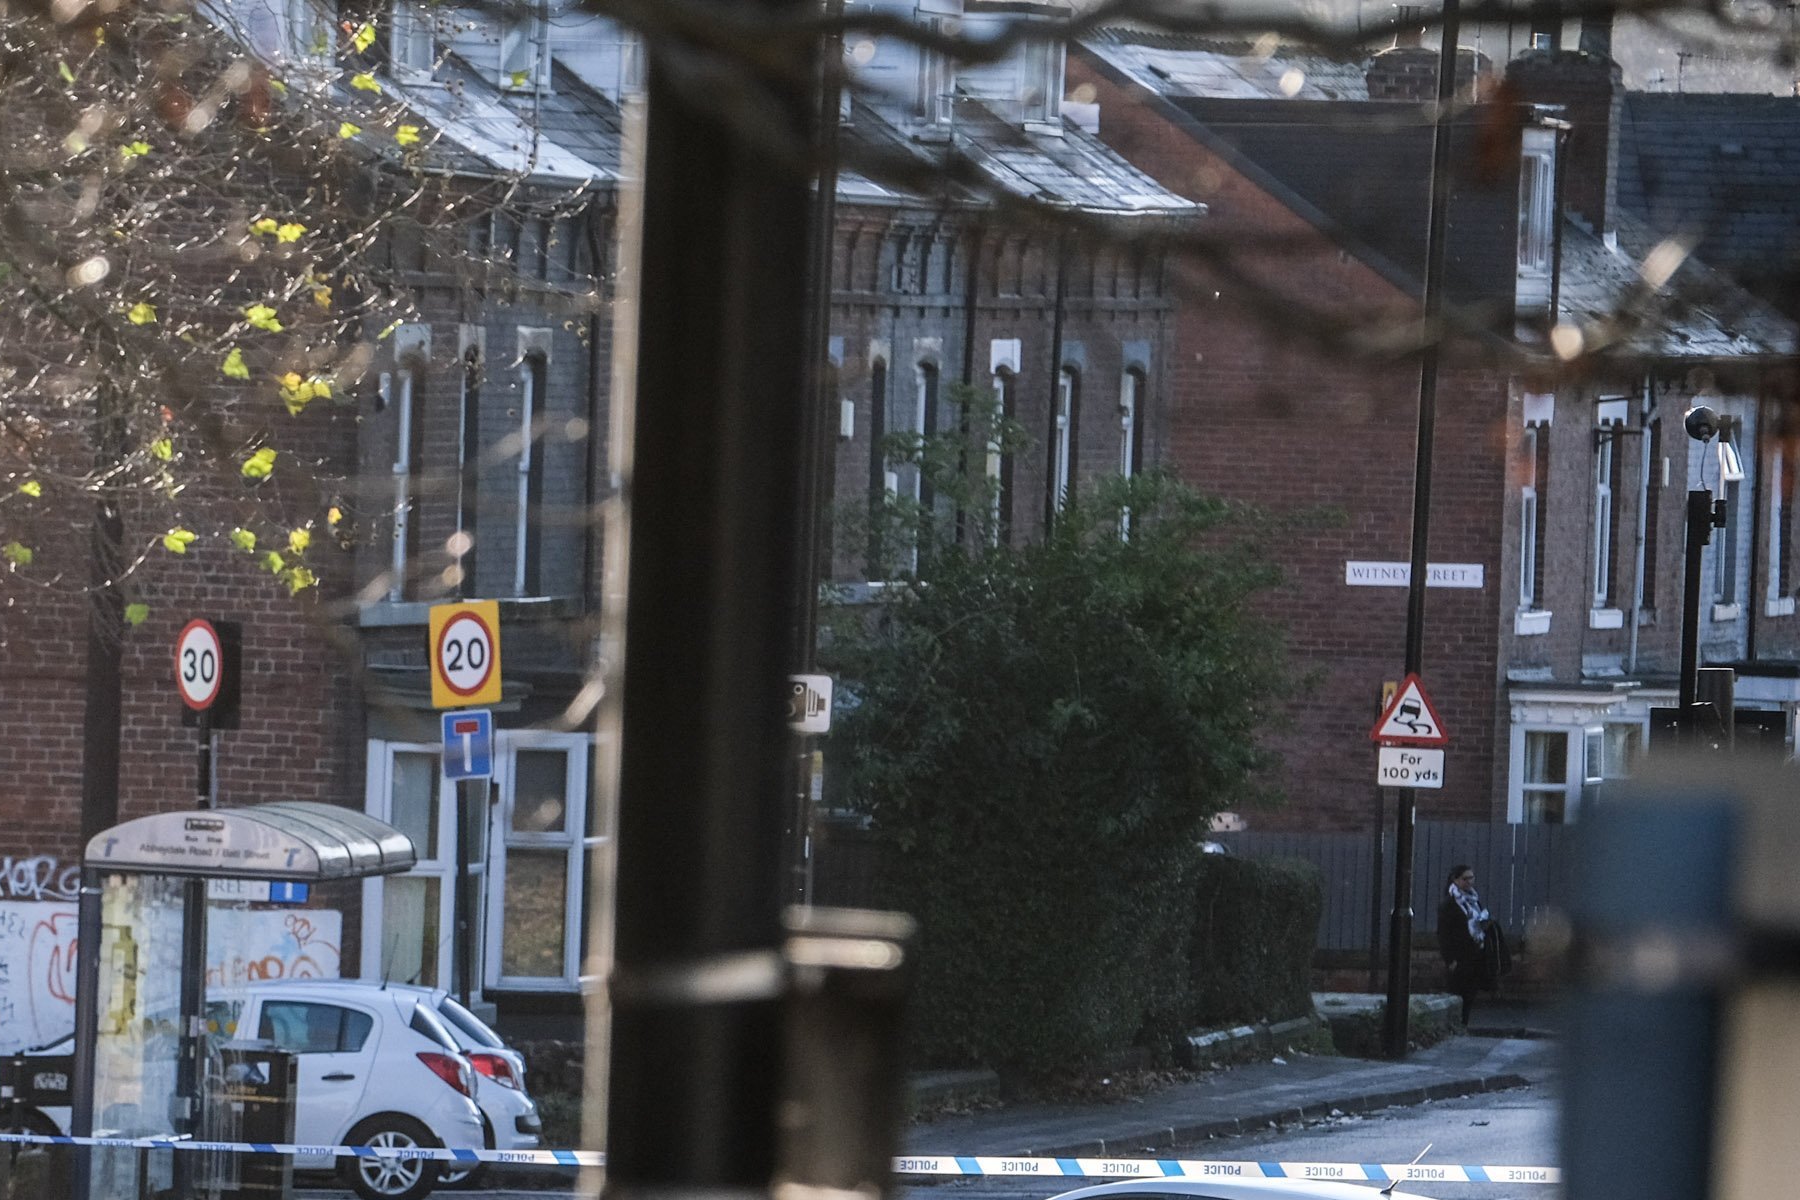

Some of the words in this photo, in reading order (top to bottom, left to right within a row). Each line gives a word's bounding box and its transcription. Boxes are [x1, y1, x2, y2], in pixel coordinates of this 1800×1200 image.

[1352, 567, 1408, 579] WITNEY
[1433, 570, 1468, 581] REET
[446, 638, 485, 671] 20
[183, 647, 215, 683] 30
[1400, 753, 1422, 765] For
[1383, 767, 1409, 779] 100
[1415, 769, 1439, 782] yds
[398, 1150, 435, 1159] POLICE
[498, 1152, 535, 1162] POLICE
[900, 1159, 938, 1171] POLICE
[1001, 1161, 1038, 1172] POLICE
[1102, 1163, 1140, 1173] POLICE
[1204, 1164, 1241, 1175] POLICE
[1305, 1166, 1343, 1177] POLICE
[1407, 1168, 1445, 1179] POLICE
[1508, 1170, 1546, 1181] POLICE
